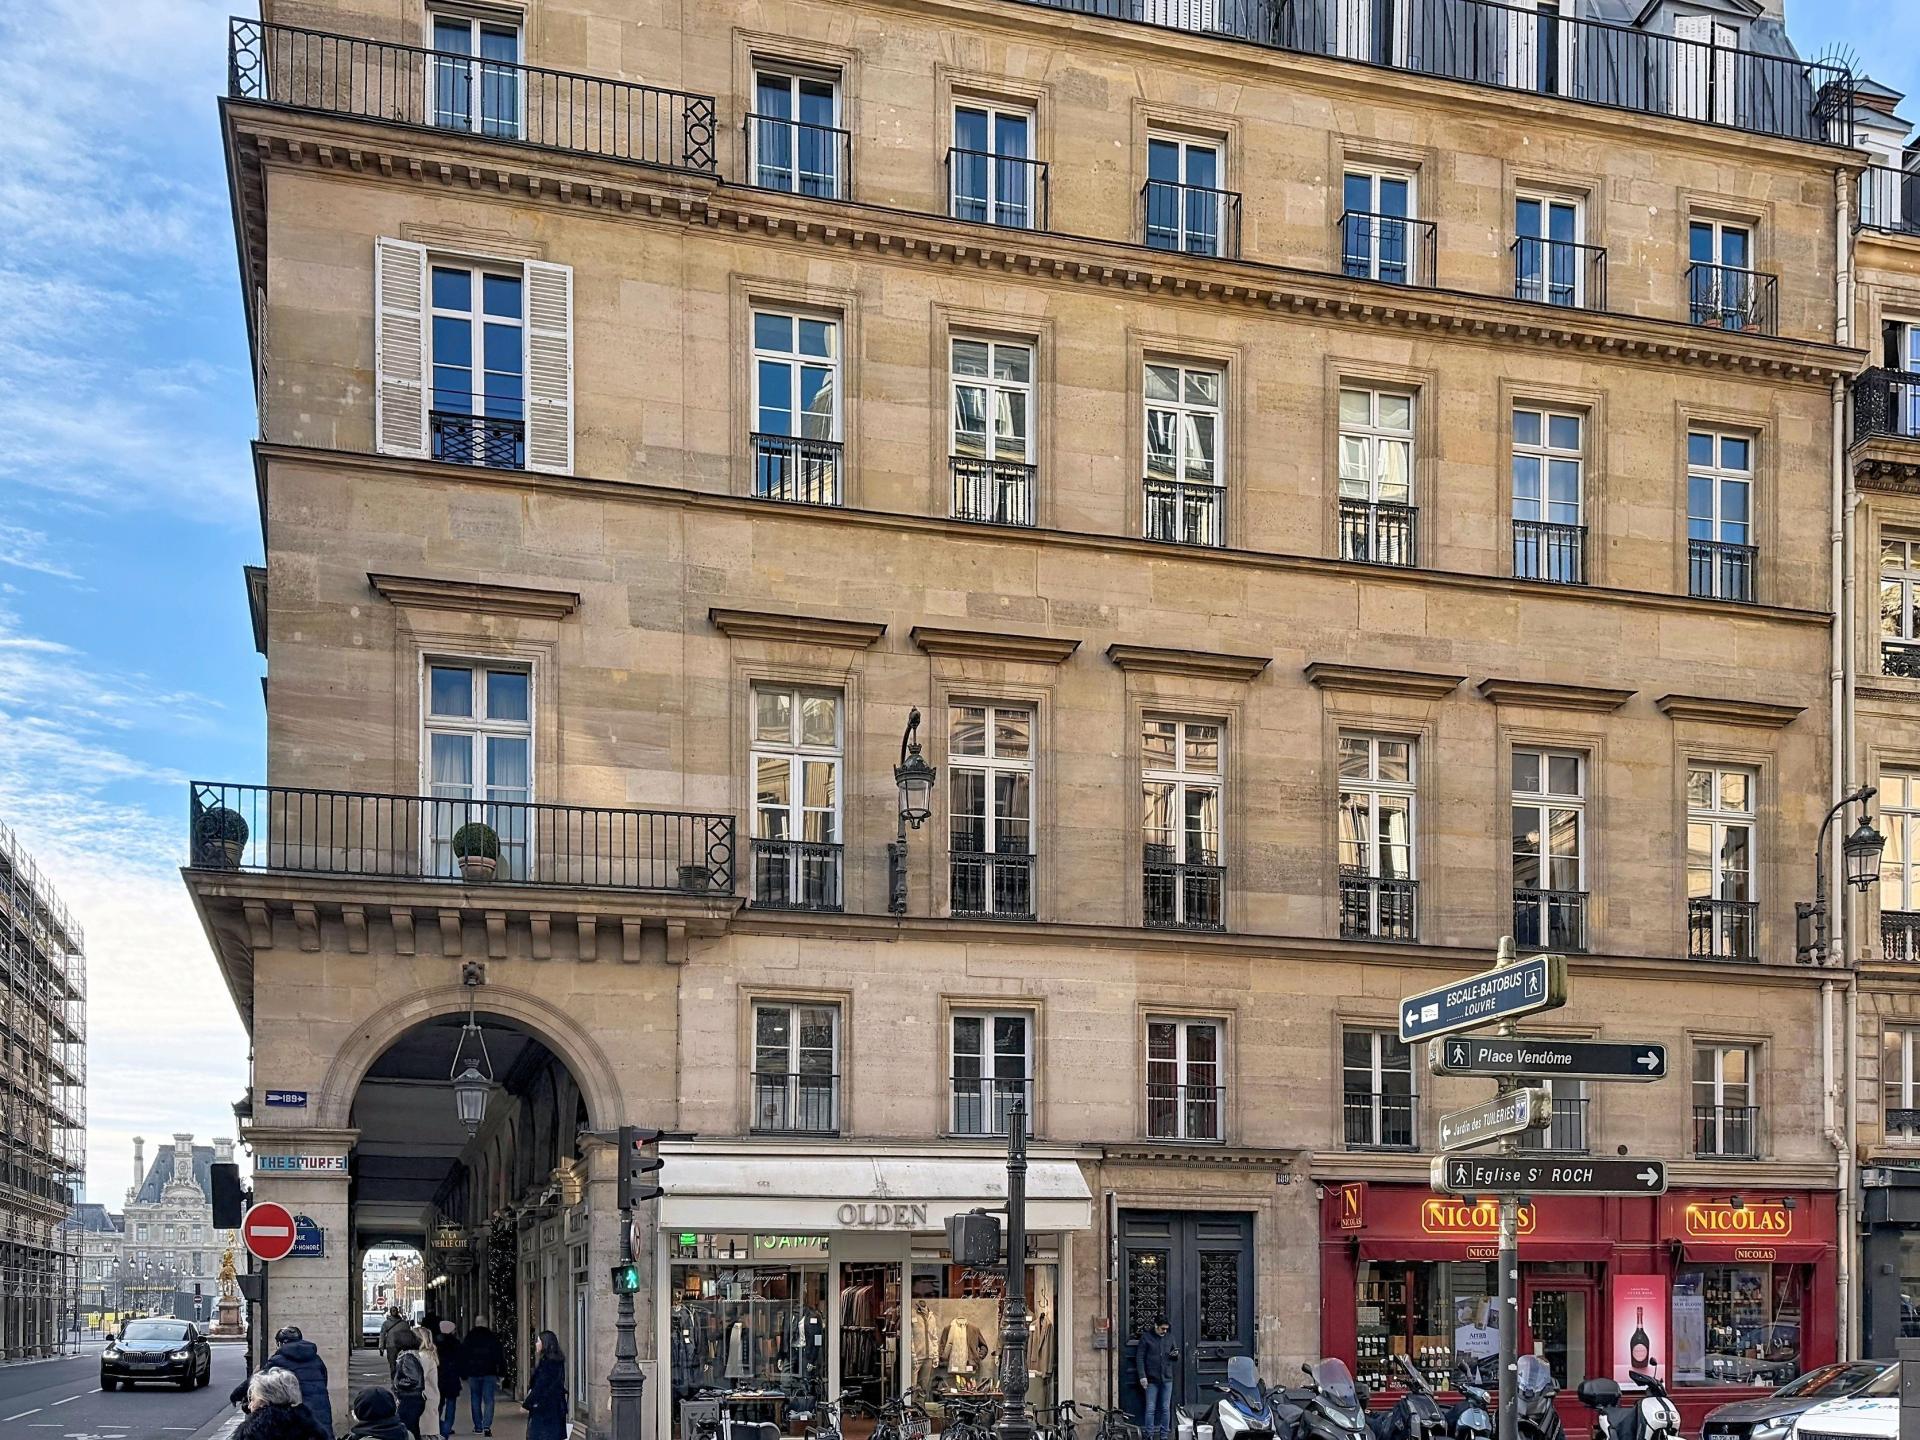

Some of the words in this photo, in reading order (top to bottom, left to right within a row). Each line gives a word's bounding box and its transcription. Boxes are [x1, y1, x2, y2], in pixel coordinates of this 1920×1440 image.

[1446, 971, 1523, 1007] ESCALE-BATOBUS
[1464, 998, 1496, 1017] LOUVRE
[1478, 1048, 1513, 1064] Place
[1516, 1049, 1572, 1065] Vendôme
[282, 1094, 298, 1103] 189
[1453, 1120, 1471, 1137] Jardin
[1471, 1118, 1482, 1130] des
[1483, 1105, 1515, 1126] TUILERIES
[260, 1156, 285, 1169] THE
[287, 1156, 343, 1169] SMURFS
[1475, 1167, 1521, 1185] Eglise
[1551, 1168, 1593, 1182] ROCH
[1344, 1188, 1358, 1216] N
[837, 1203, 928, 1225] OLDEN
[1429, 1206, 1529, 1227] NICOLS
[1692, 1210, 1786, 1230] NICOLAS
[1469, 1248, 1499, 1257] NICOL
[1737, 1250, 1774, 1259] NICOLAS
